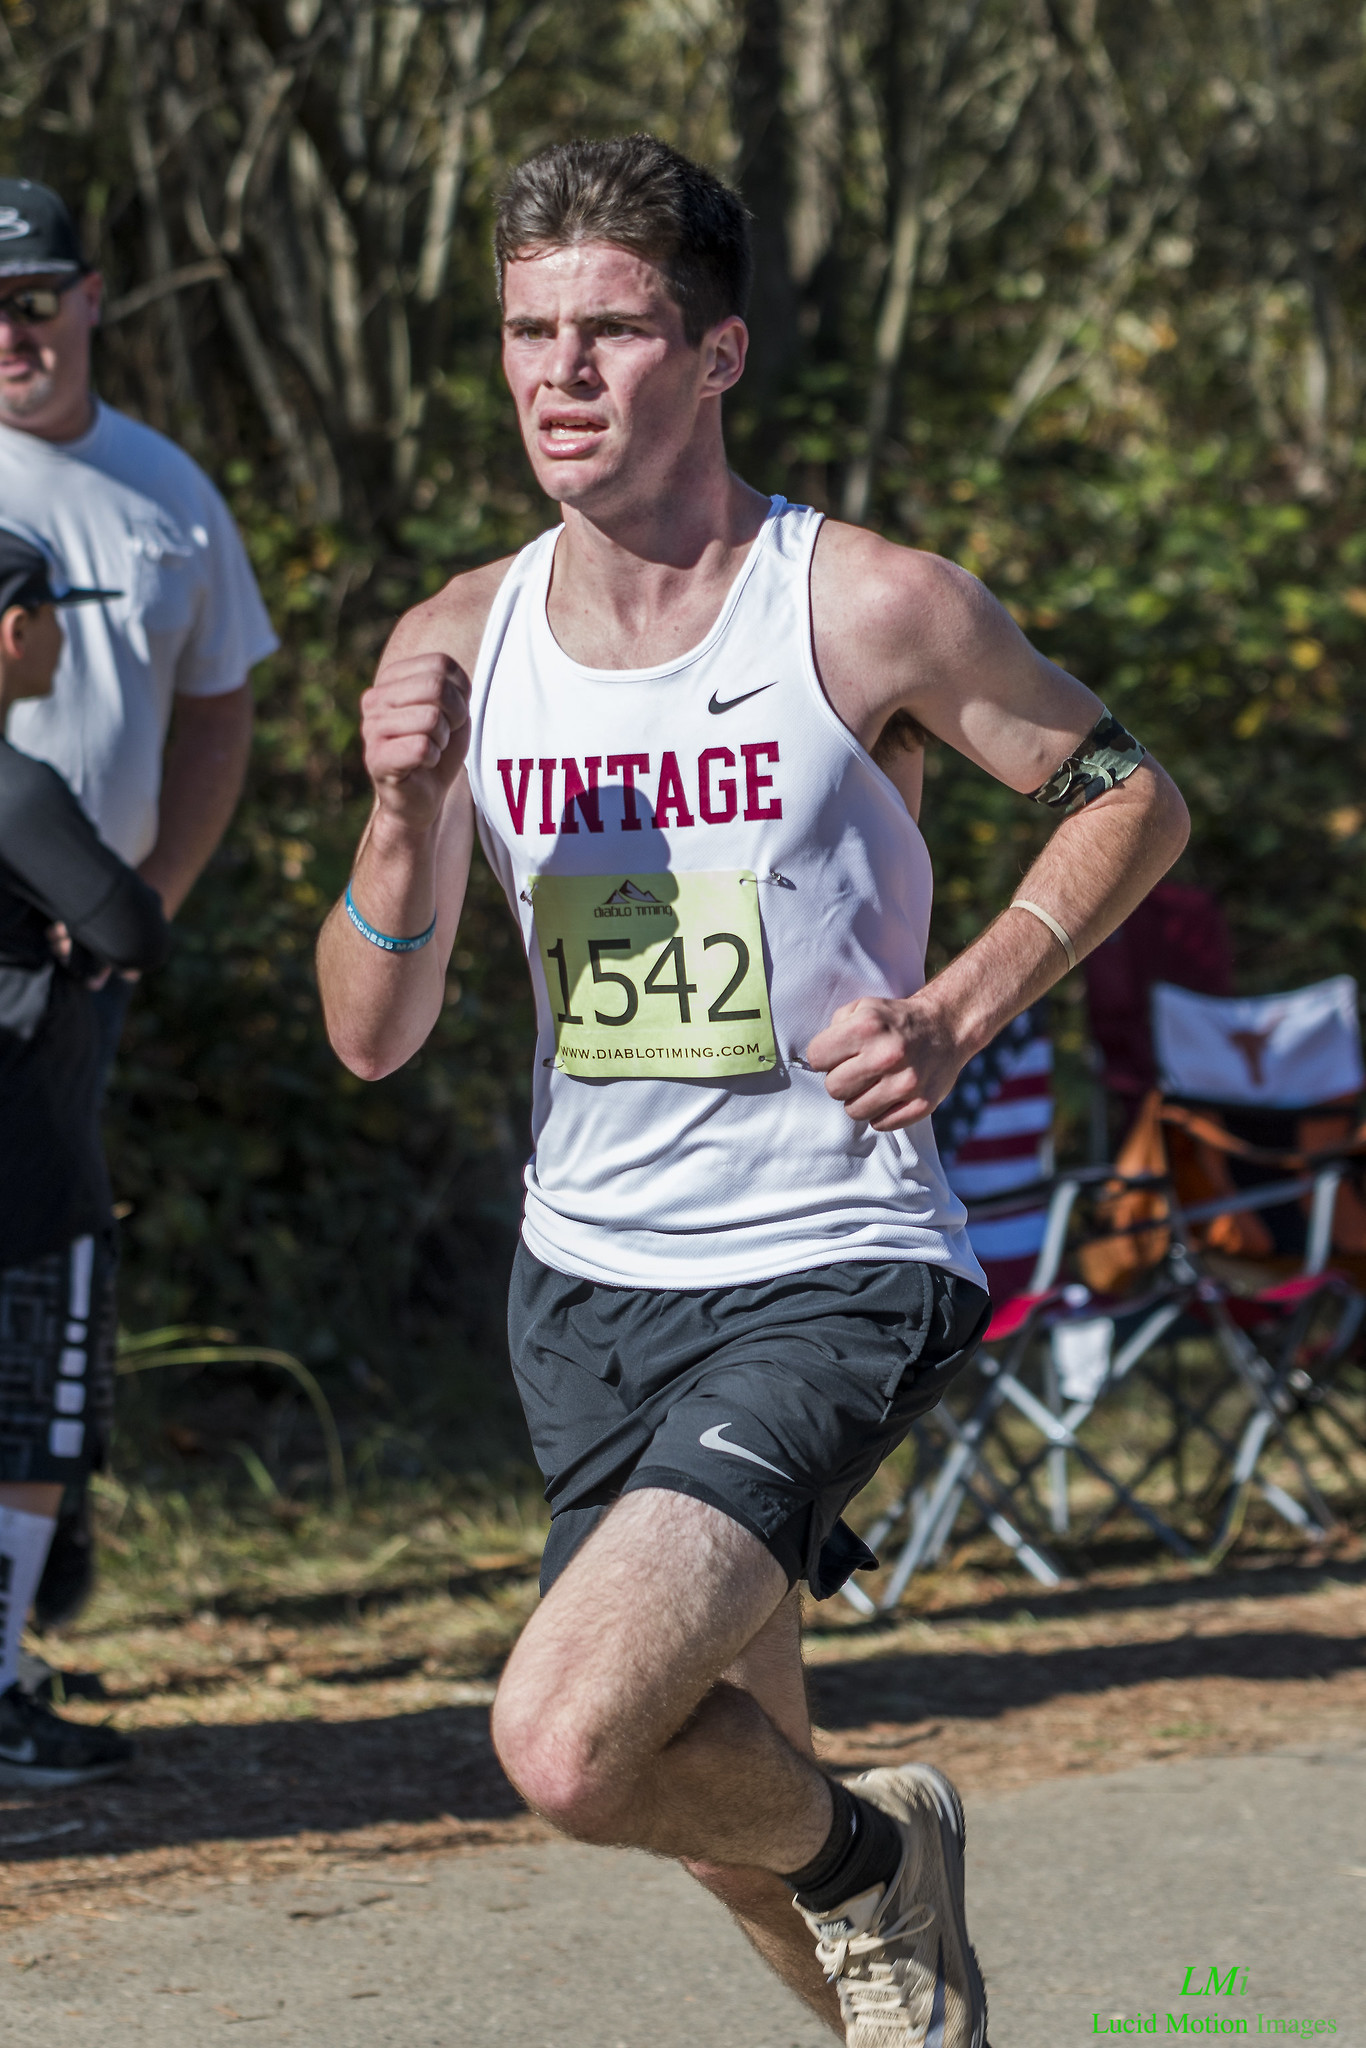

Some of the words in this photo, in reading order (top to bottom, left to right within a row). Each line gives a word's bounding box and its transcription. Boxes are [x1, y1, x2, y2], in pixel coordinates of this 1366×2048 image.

[497, 741, 783, 835] VINTAGE
[347, 903, 394, 950] KINDNESS
[547, 932, 761, 1026] 1542
[560, 1043, 760, 1060] WWW.DIABLOTIMING.COM
